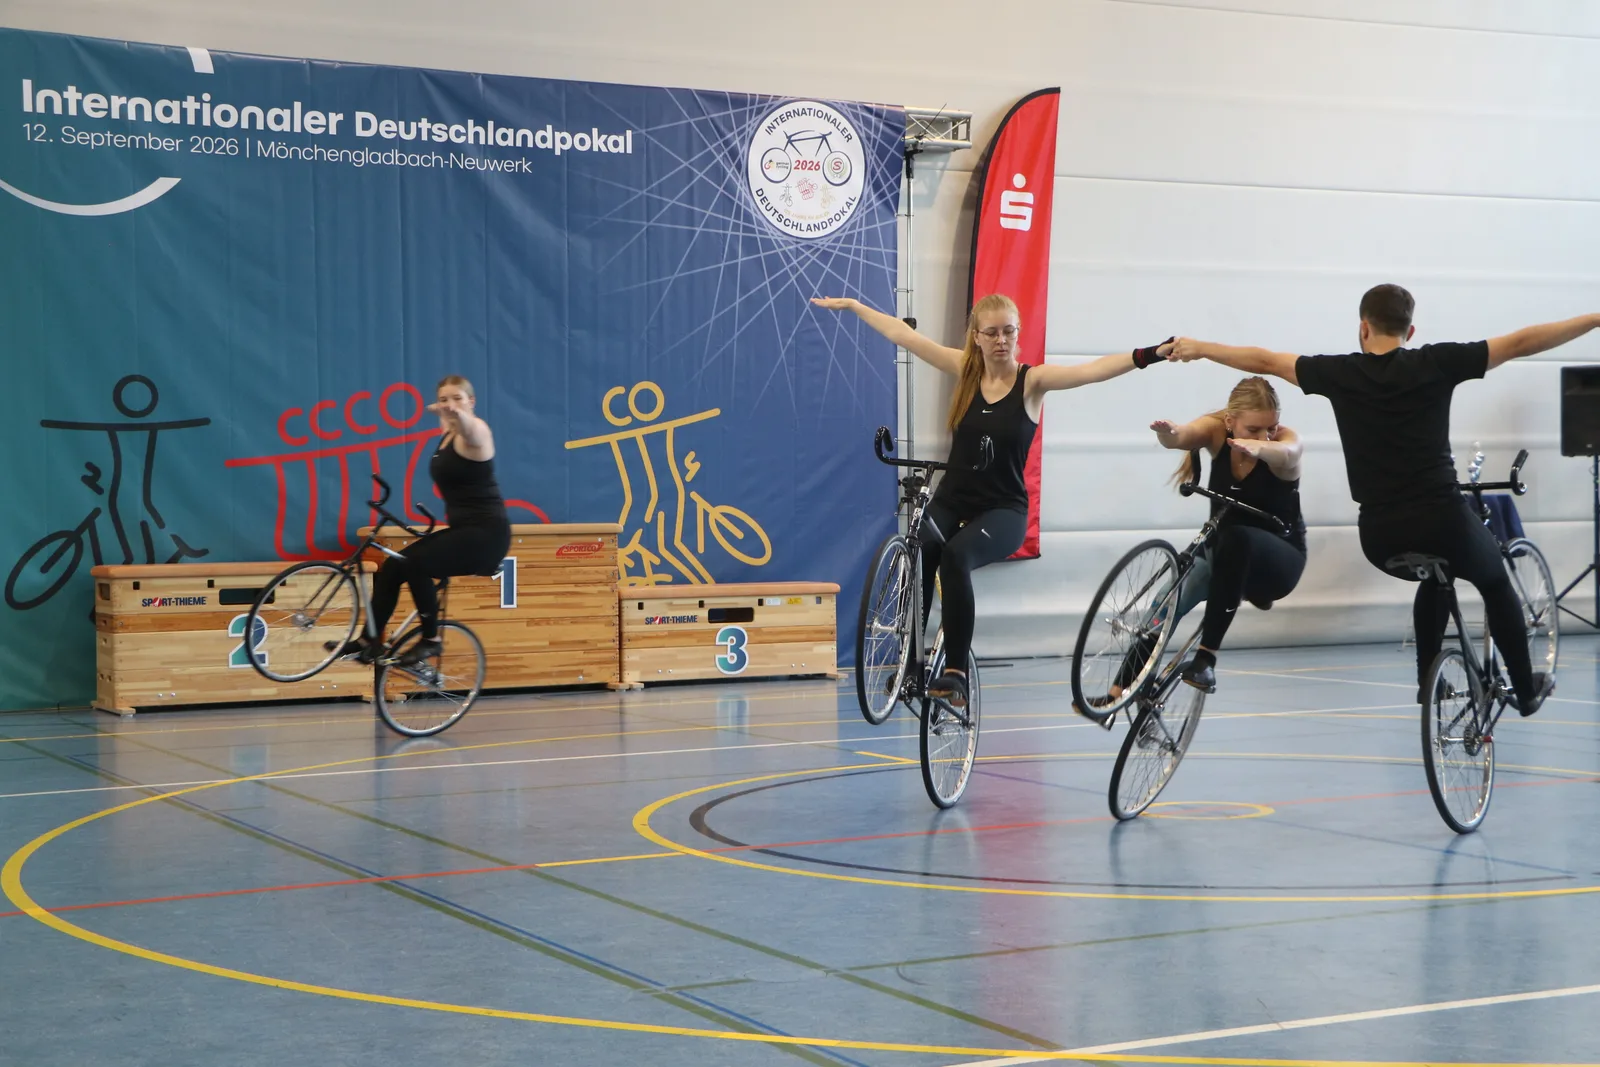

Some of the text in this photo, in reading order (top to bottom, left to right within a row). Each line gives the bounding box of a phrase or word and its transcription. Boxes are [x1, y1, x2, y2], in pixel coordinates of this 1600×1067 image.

[22, 78, 633, 155] Internationaler Deutschlandpokal
[764, 107, 853, 143] INTERNATIONALER
[23, 123, 54, 142] 12.
[61, 126, 183, 152] September
[190, 135, 239, 156] 2026
[257, 140, 533, 173] Mönchengladbach-Neuwerk
[793, 159, 821, 172] 2026
[755, 188, 857, 232] DEUTSCHLANDPOKAL
[142, 596, 207, 608] SPORT-THIEME
[491, 555, 518, 609] 1
[227, 612, 269, 668] 2
[645, 614, 698, 625] SPORT-THIEME
[714, 625, 750, 675] 3
